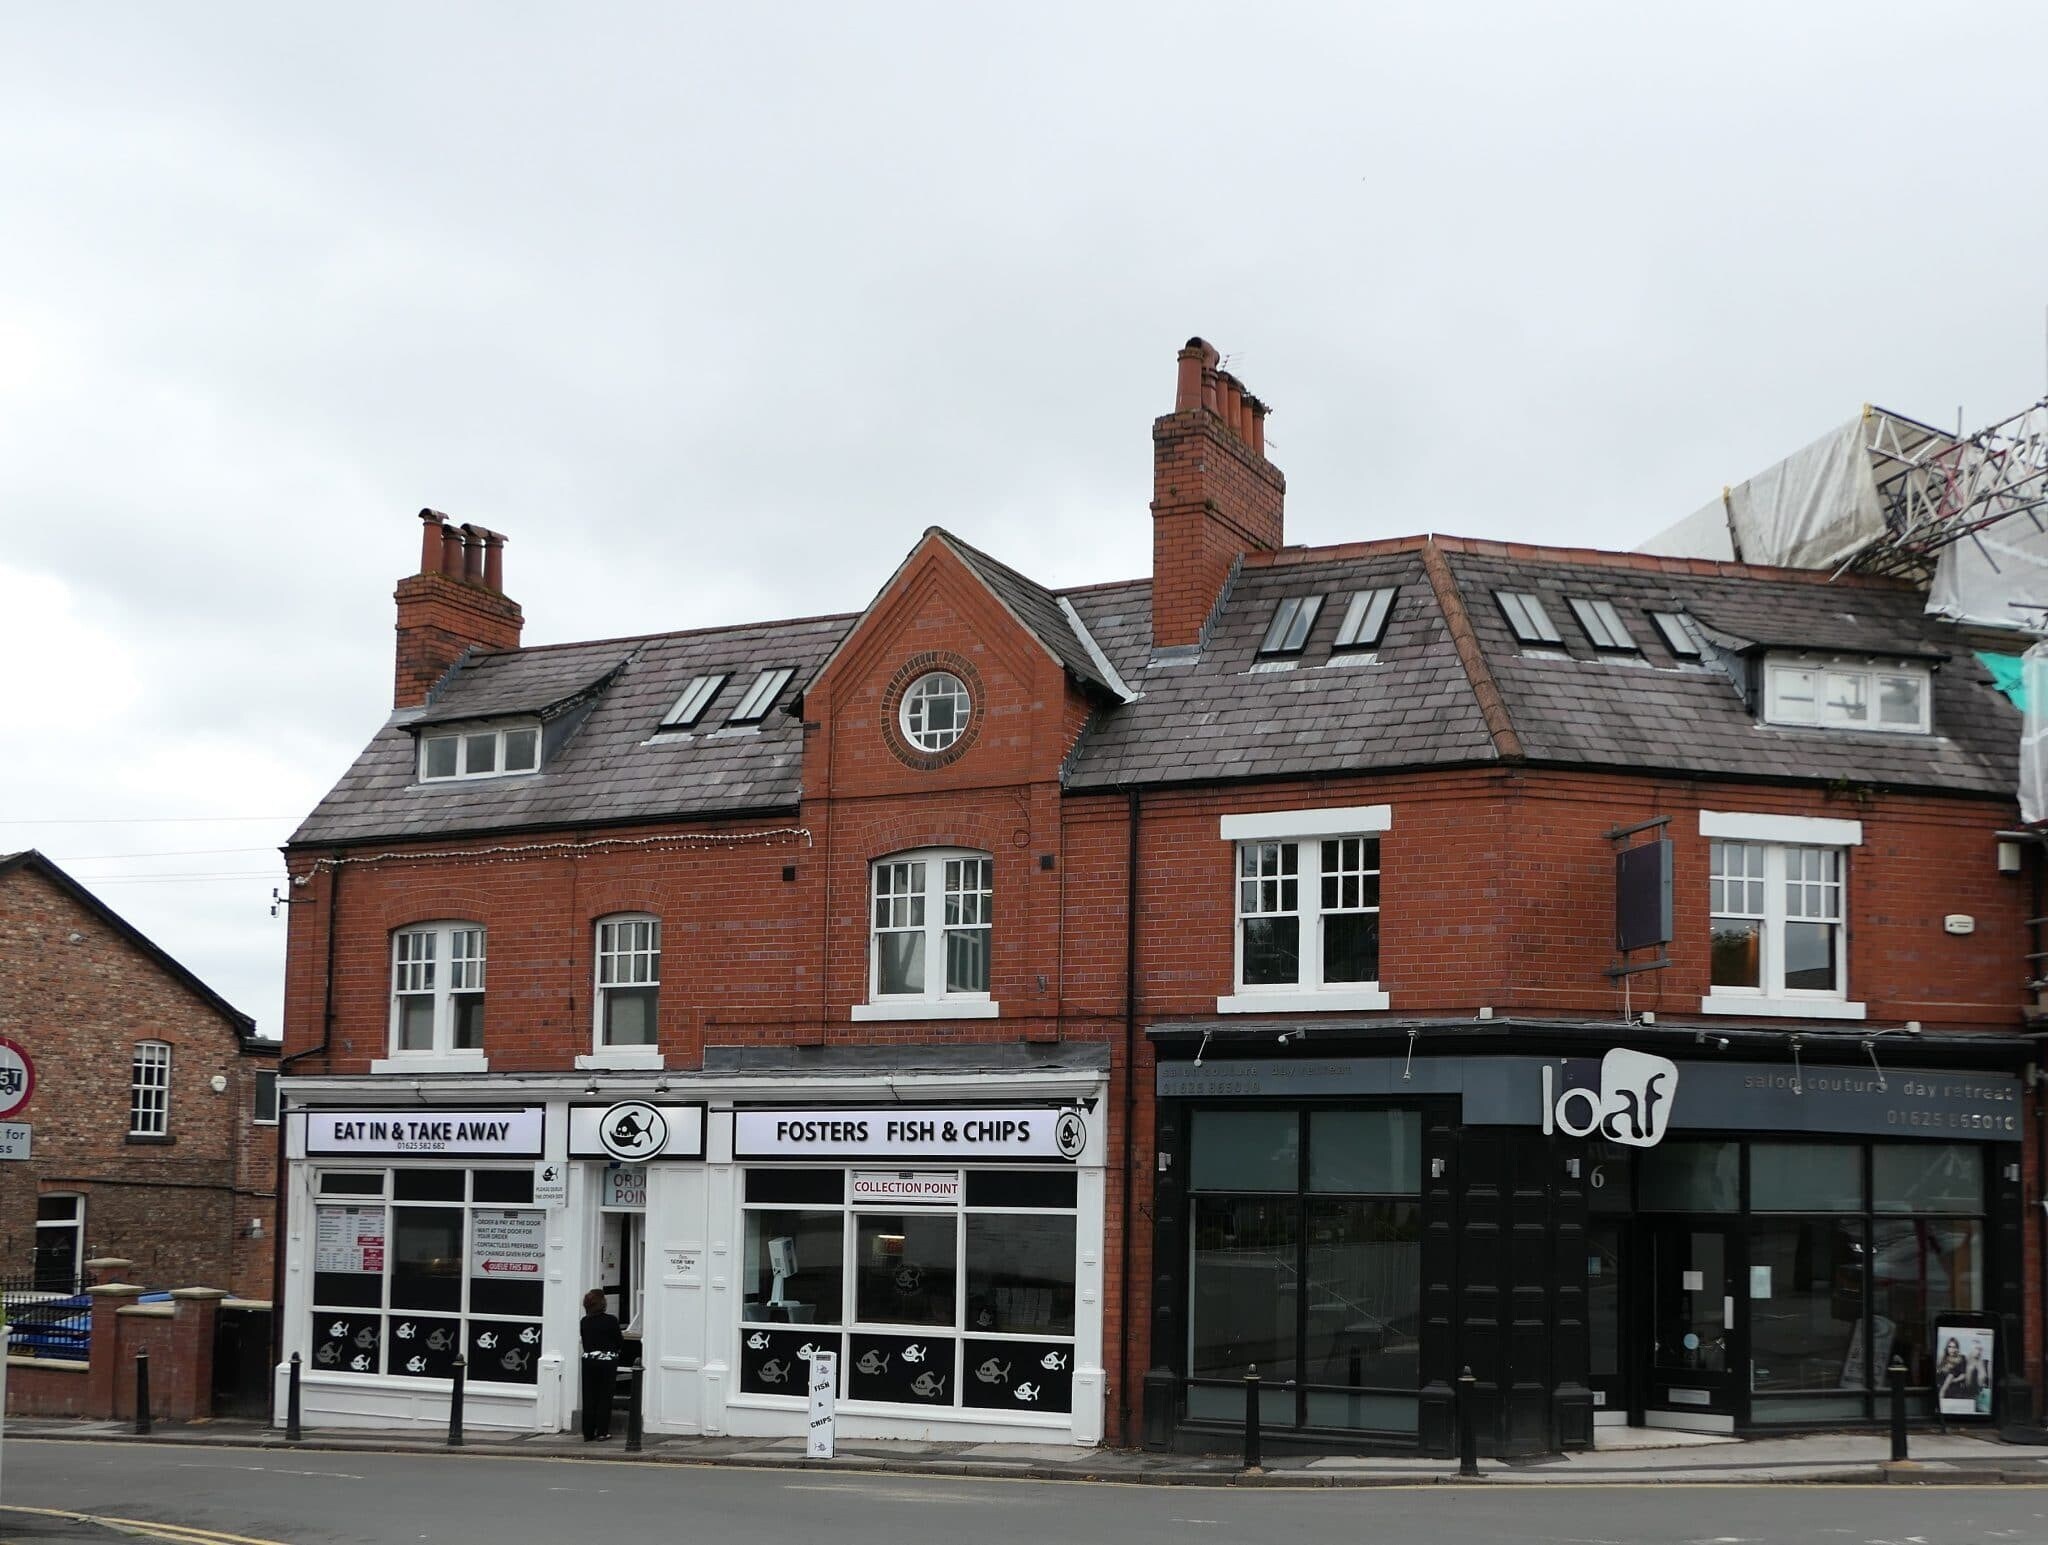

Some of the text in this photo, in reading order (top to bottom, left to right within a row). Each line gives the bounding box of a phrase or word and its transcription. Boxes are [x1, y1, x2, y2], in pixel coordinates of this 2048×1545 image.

[1903, 1081, 1936, 1098] day
[1944, 1085, 2014, 1101] retreat
[1542, 1065, 1666, 1139] loaf
[6, 1129, 26, 1140] for
[334, 1121, 510, 1141] EAT IN & TAKE AWAY
[776, 1121, 1031, 1142] FOSTERS FISH & CHIPS
[397, 1141, 446, 1150] 01625 582 682
[1590, 1165, 1605, 1188] 6
[854, 1181, 959, 1194] COLLECTION POINT
[814, 1381, 830, 1392] FISH
[810, 1415, 832, 1429] CHIPS
